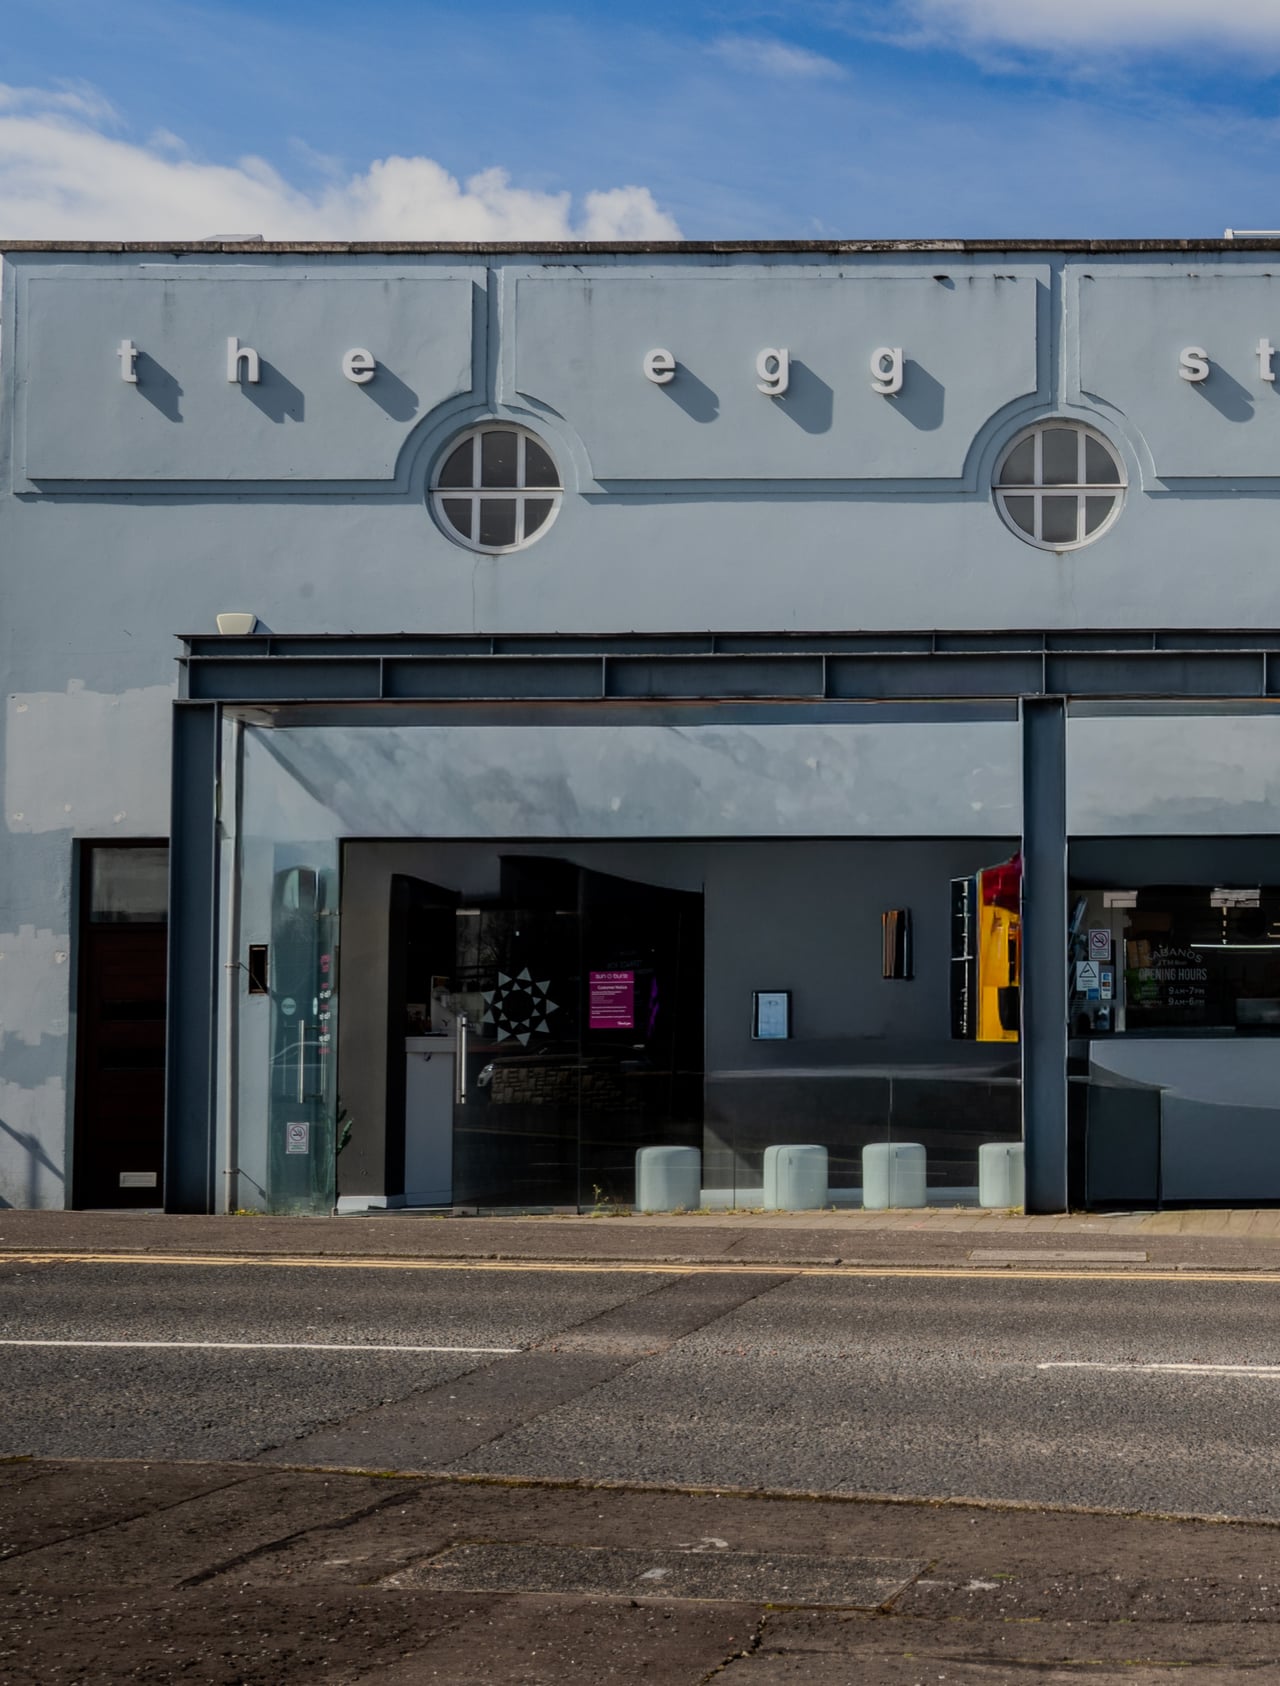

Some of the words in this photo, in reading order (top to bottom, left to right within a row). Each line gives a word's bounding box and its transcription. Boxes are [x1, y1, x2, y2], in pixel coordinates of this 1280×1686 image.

[117, 336, 376, 385] the
[643, 347, 905, 395] egg
[1138, 967, 1177, 982] OPENING
[1177, 967, 1208, 981] HOURS
